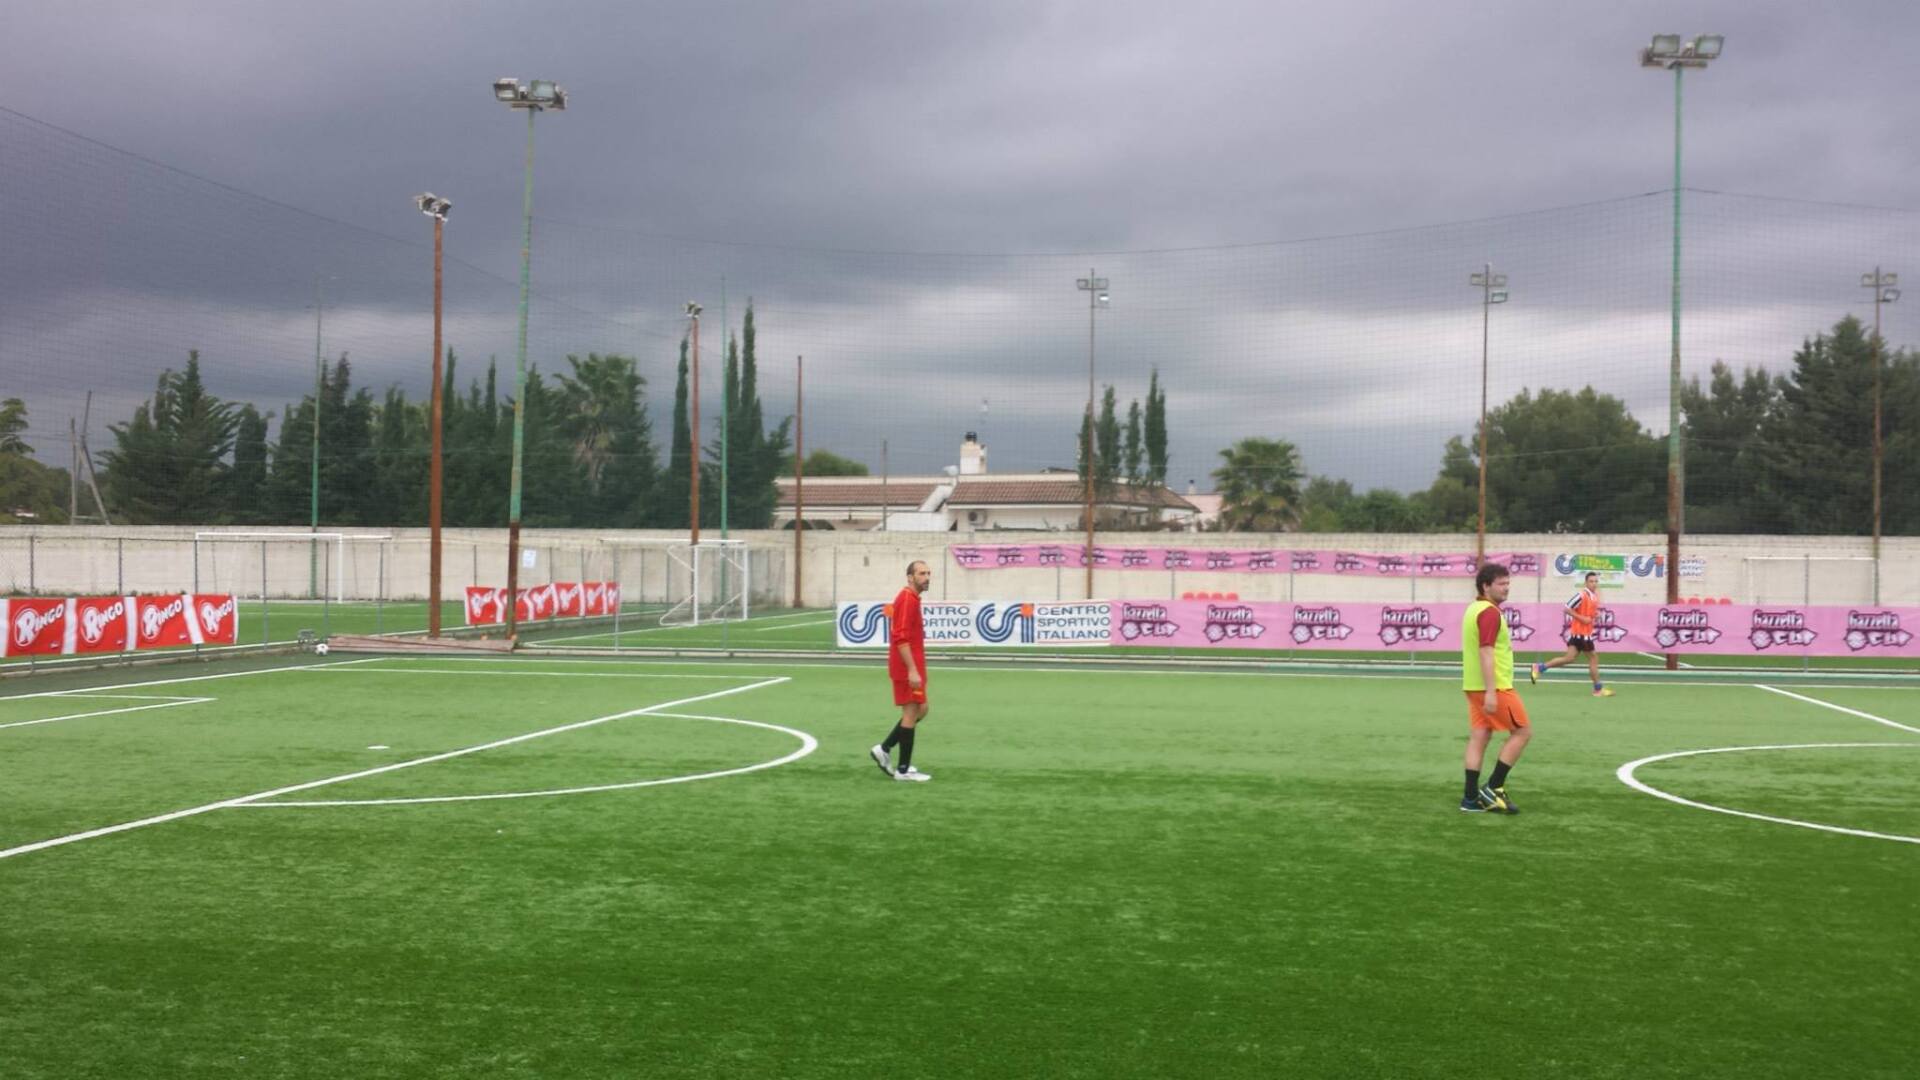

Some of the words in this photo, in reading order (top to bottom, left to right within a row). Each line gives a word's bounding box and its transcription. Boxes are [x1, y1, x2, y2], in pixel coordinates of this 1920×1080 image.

[202, 599, 232, 633] RINGO
[923, 606, 970, 615] NTRO
[1037, 605, 1110, 616] CENTRO
[15, 604, 64, 644] RINGO
[82, 602, 124, 642] RINGO
[143, 600, 182, 638] RINGO
[1038, 617, 1110, 627] SPORTIVO
[923, 630, 971, 639] LIANO
[1038, 629, 1110, 639] ITALIANO
